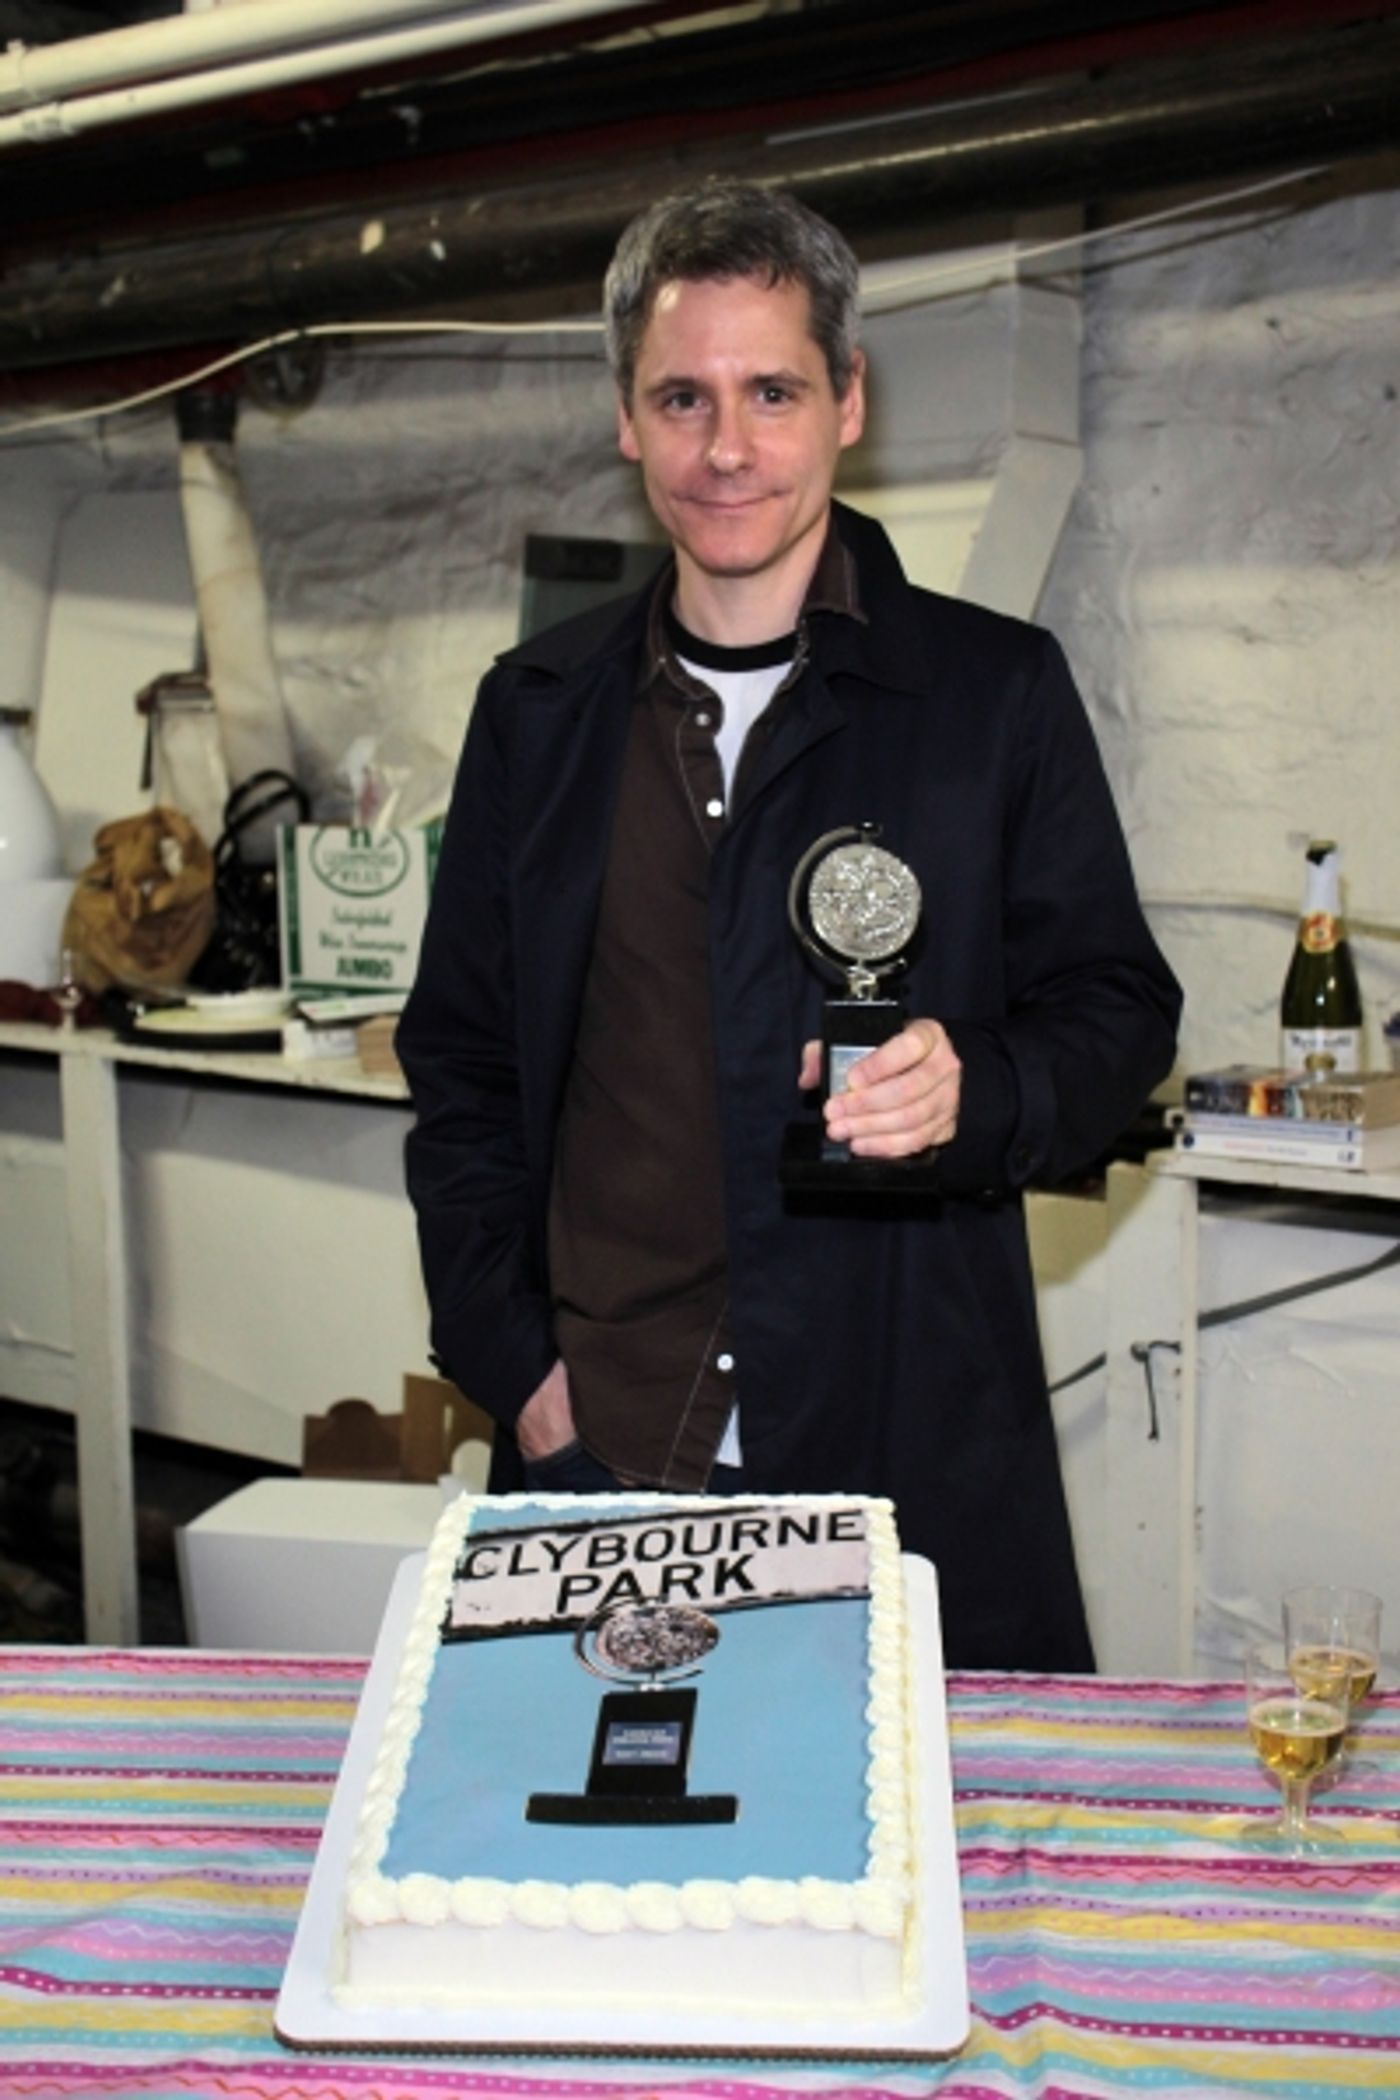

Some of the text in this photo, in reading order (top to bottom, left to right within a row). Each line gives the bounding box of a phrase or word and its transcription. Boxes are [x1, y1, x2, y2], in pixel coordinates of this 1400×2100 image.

[336, 957, 393, 980] JUMBO
[467, 1509, 867, 1580] CLYBOURNE
[555, 1553, 756, 1615] PARK
